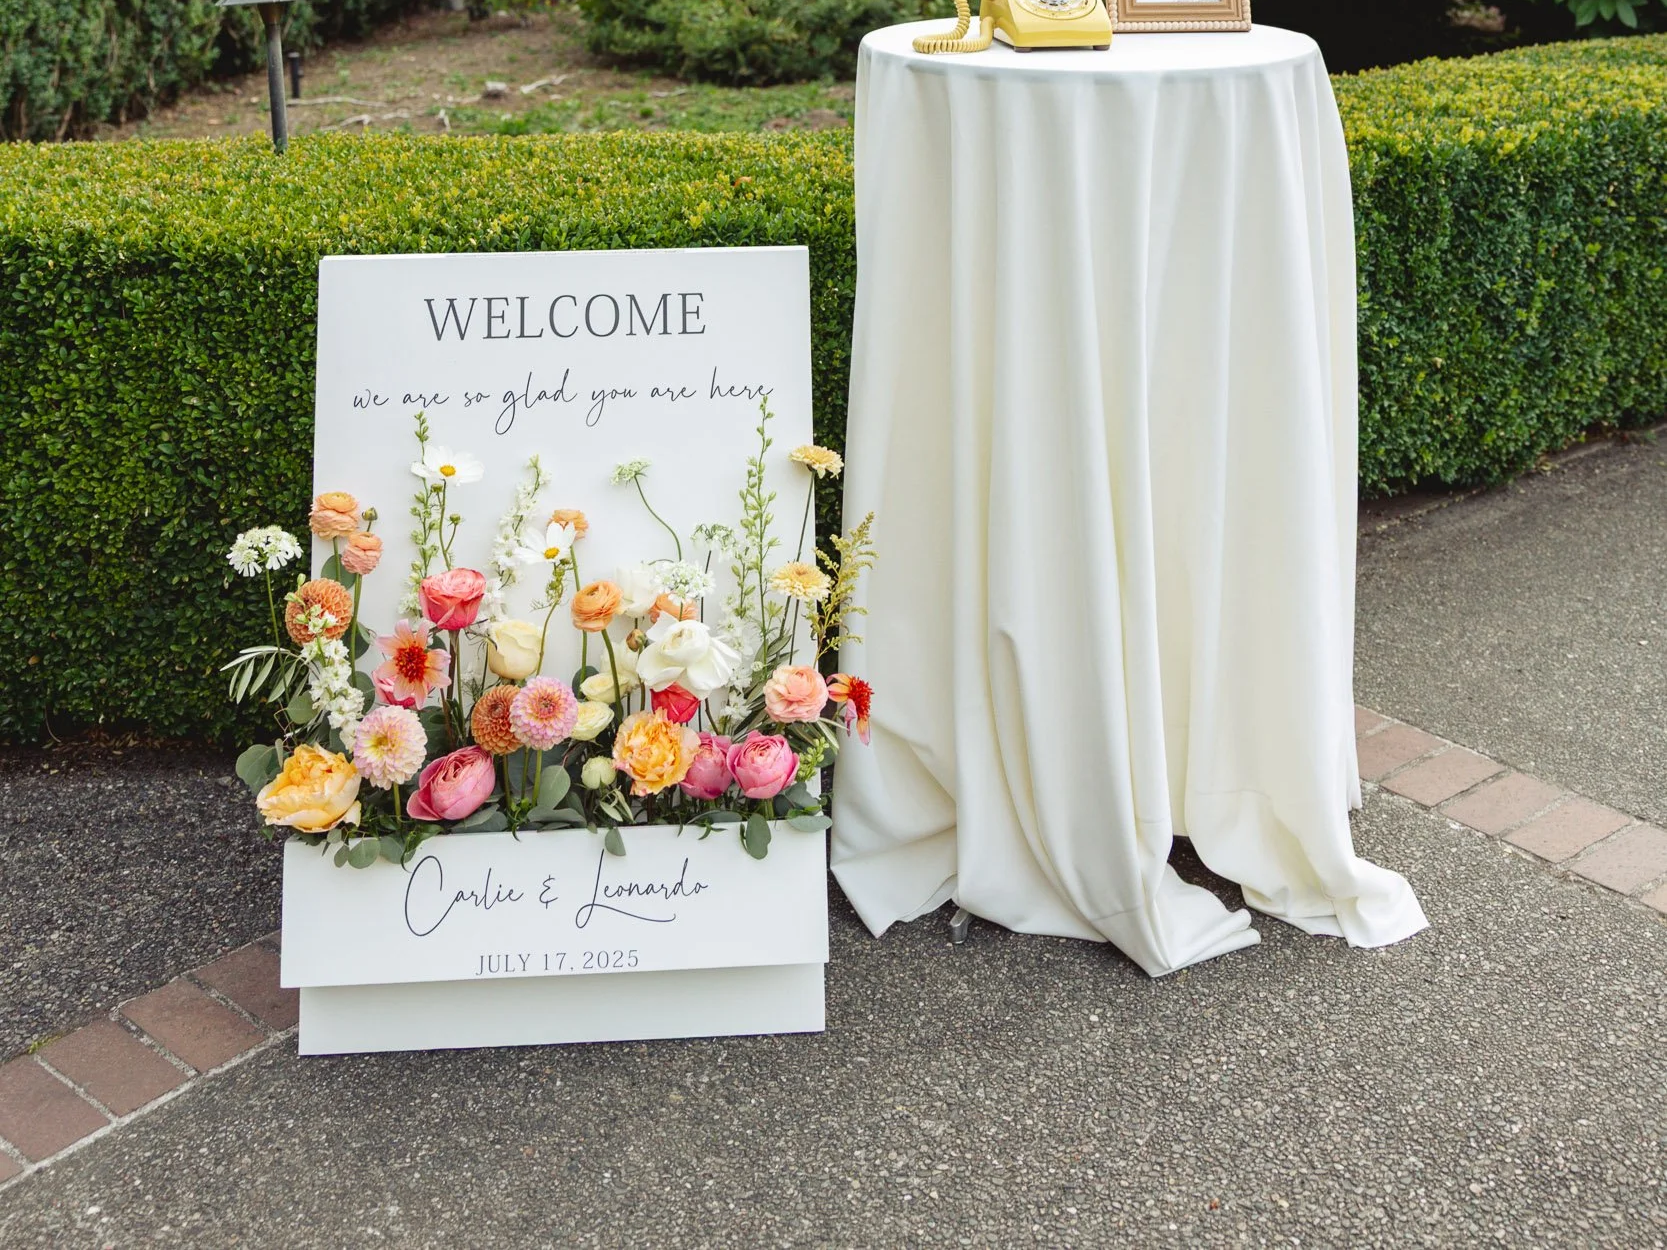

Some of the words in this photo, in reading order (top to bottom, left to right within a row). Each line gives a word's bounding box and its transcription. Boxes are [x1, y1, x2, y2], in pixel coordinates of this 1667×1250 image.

[423, 292, 707, 342] WELCOME
[353, 388, 390, 409] we
[402, 393, 450, 409] are
[464, 391, 491, 408] so
[495, 368, 578, 436] glad
[585, 388, 638, 427] you
[650, 386, 697, 402] are
[710, 366, 774, 401] here
[404, 854, 524, 937] Carlie
[538, 874, 558, 910] &
[575, 848, 709, 930] Leonardo
[475, 953, 531, 976] JULY
[543, 952, 574, 971] 17,
[582, 949, 639, 969] 2025
